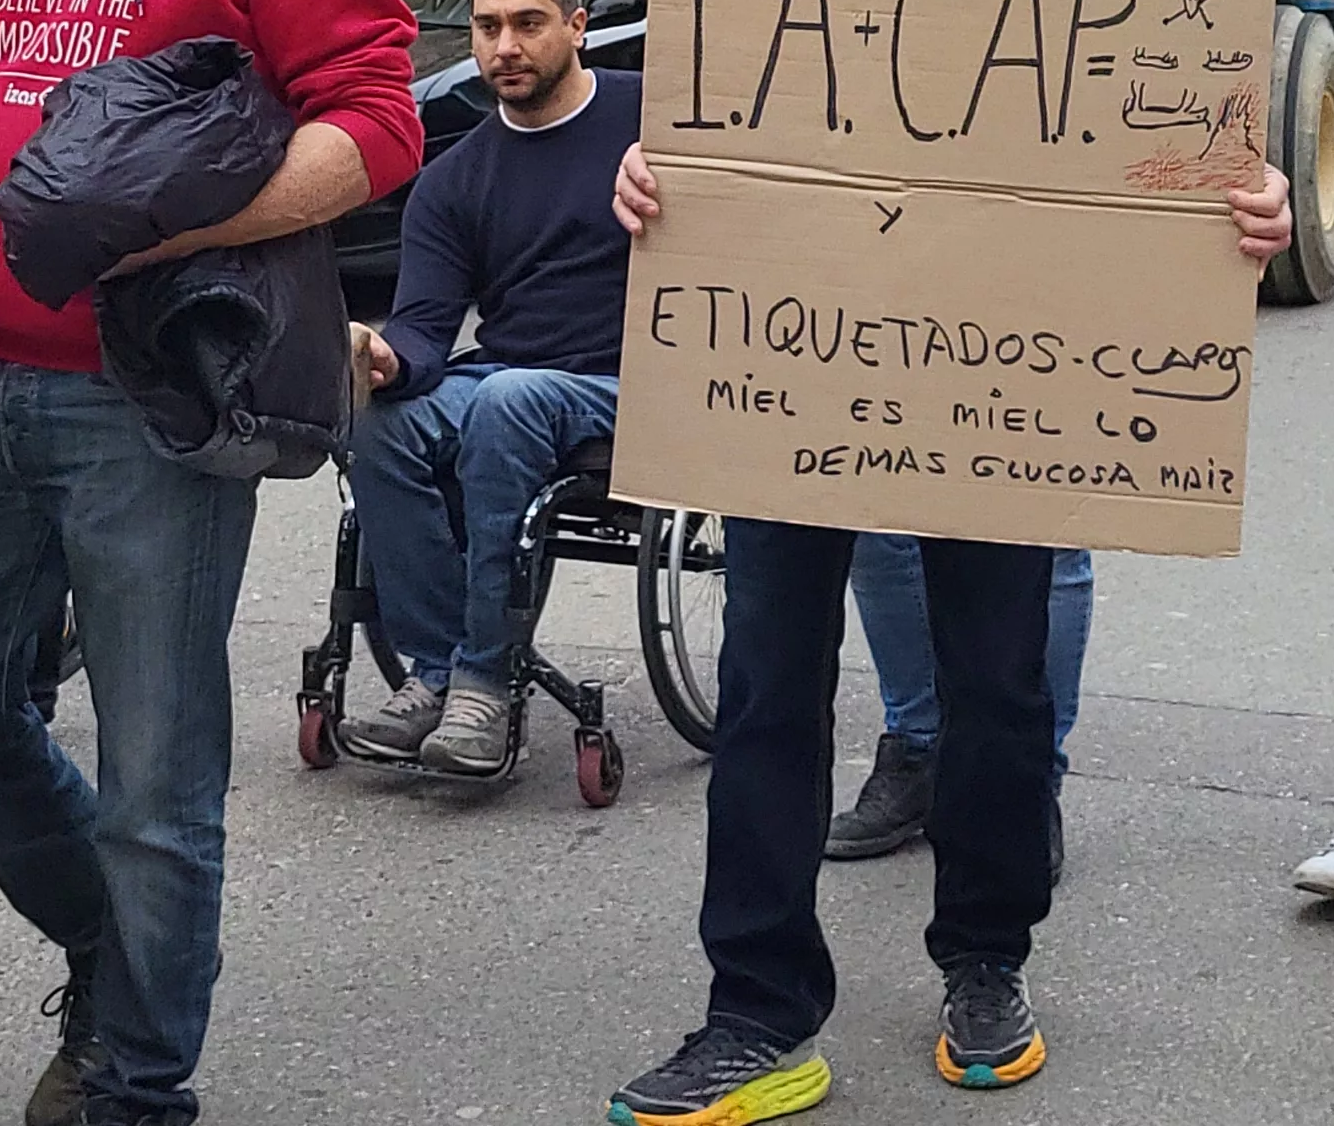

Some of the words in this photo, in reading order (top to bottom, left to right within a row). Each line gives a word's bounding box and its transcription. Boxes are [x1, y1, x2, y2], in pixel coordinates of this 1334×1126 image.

[4, 83, 37, 105] izas
[874, 200, 904, 234] Y
[706, 373, 797, 416] MIEL
[850, 398, 904, 425] ES
[953, 387, 1062, 435] MIEL
[1096, 410, 1157, 442] LO
[793, 444, 947, 476] DEMAS
[970, 454, 1141, 491] GLUCOSA
